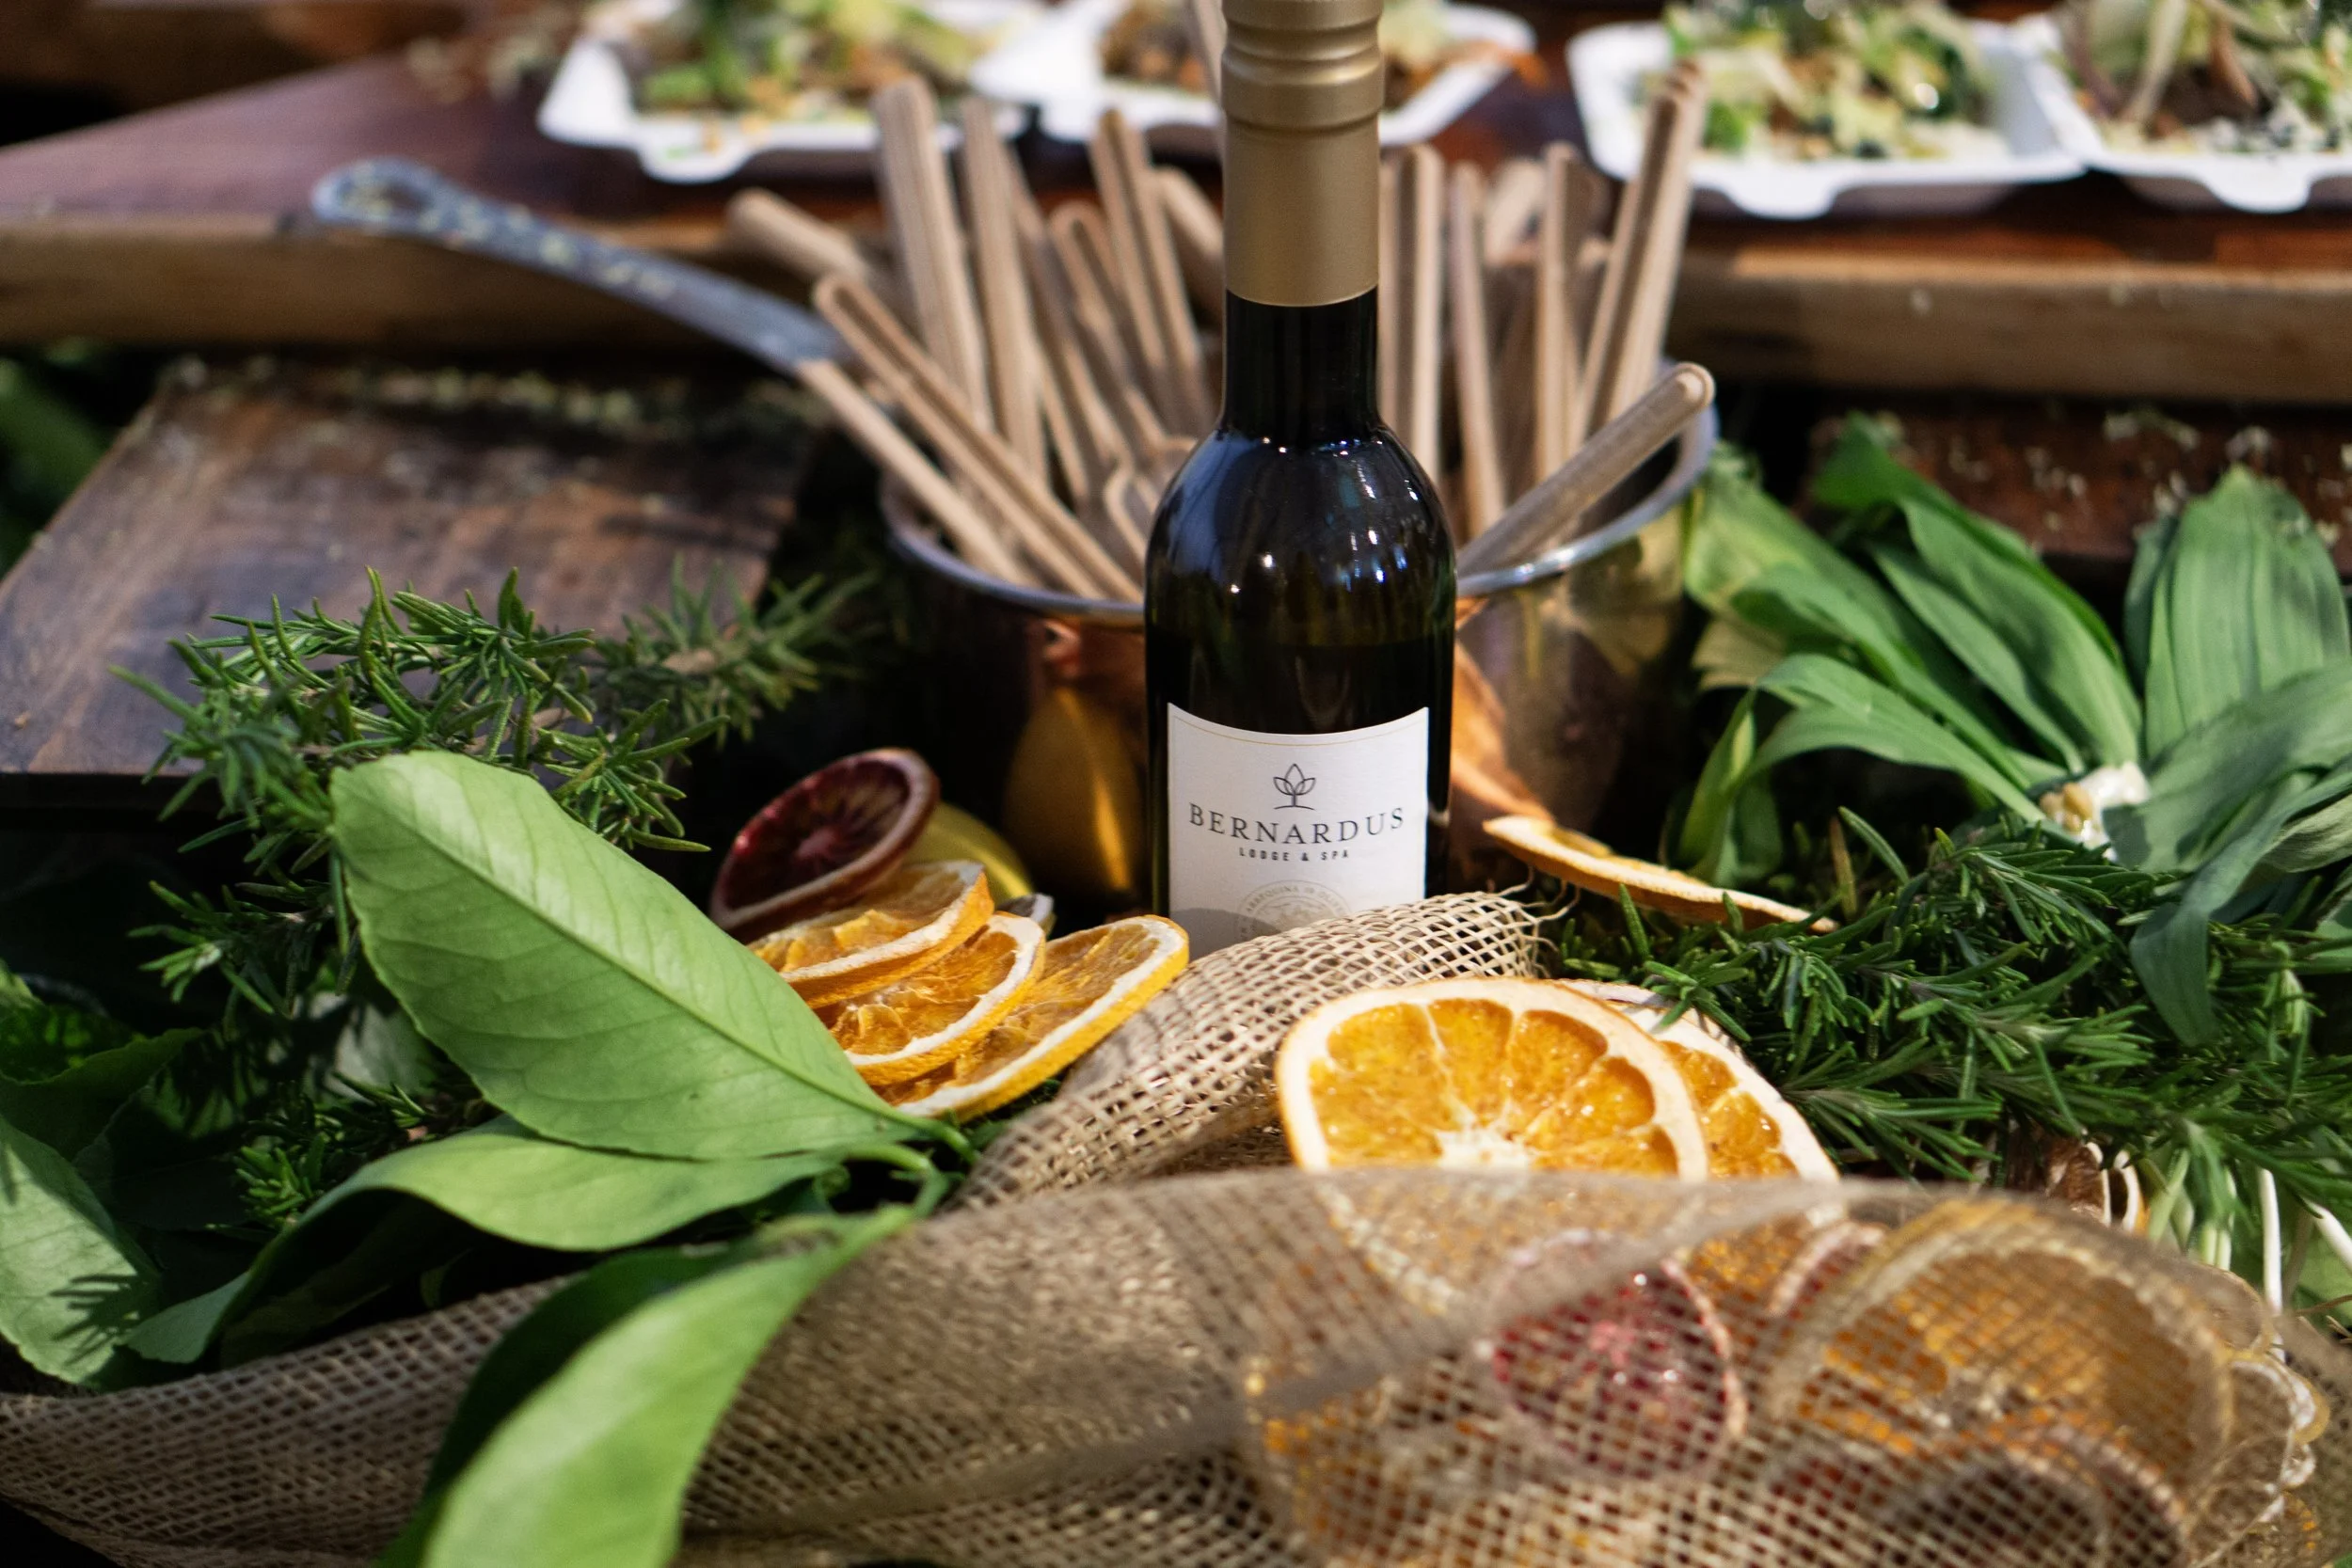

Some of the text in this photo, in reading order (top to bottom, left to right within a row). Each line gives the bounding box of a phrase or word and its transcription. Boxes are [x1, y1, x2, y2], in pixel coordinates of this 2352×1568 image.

[1189, 803, 1405, 844] BERNARDUS
[1239, 847, 1348, 862] LODGE & SPA
